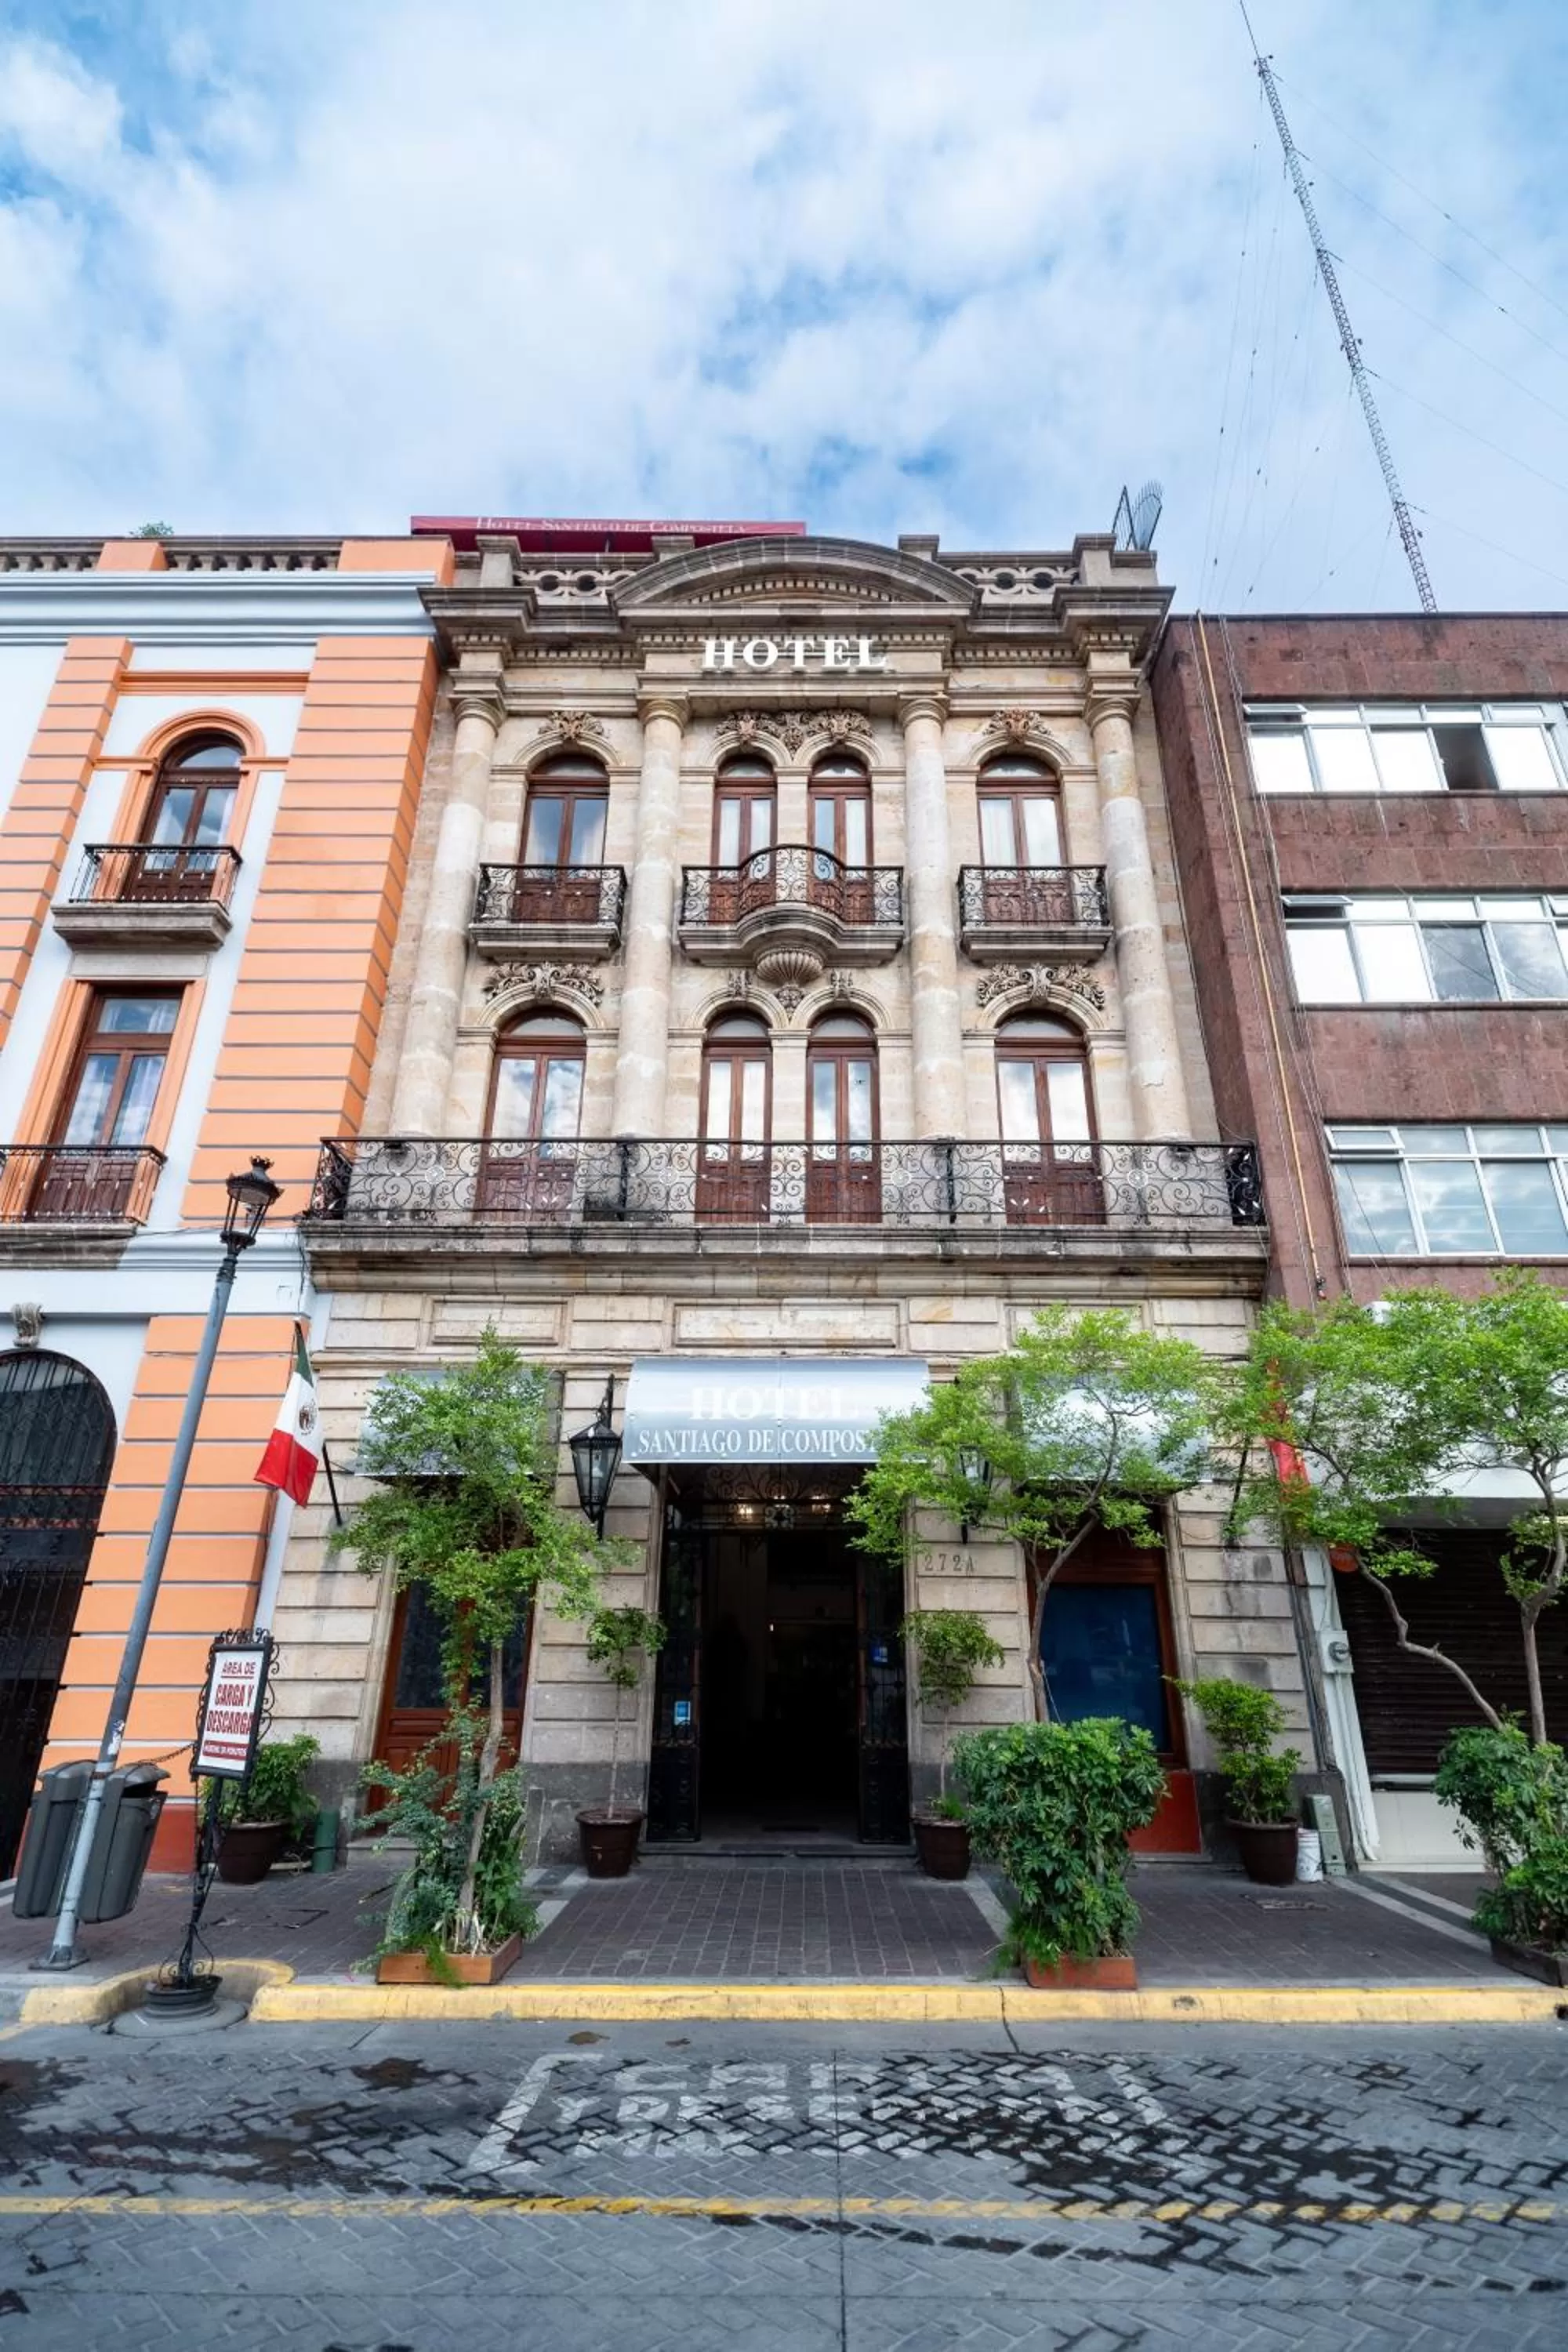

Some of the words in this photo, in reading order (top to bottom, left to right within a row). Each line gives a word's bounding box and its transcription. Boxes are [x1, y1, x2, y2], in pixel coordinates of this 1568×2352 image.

[476, 516, 531, 530] HOTEL
[702, 638, 891, 668] HOTEL
[688, 1386, 858, 1421] HOTEL
[638, 1428, 742, 1454] SANTIAGO
[748, 1428, 775, 1454] DE
[245, 1661, 256, 1675] DE
[216, 1683, 245, 1707] CARGA
[247, 1683, 254, 1708] Y
[206, 1710, 253, 1735] DESCARGA
